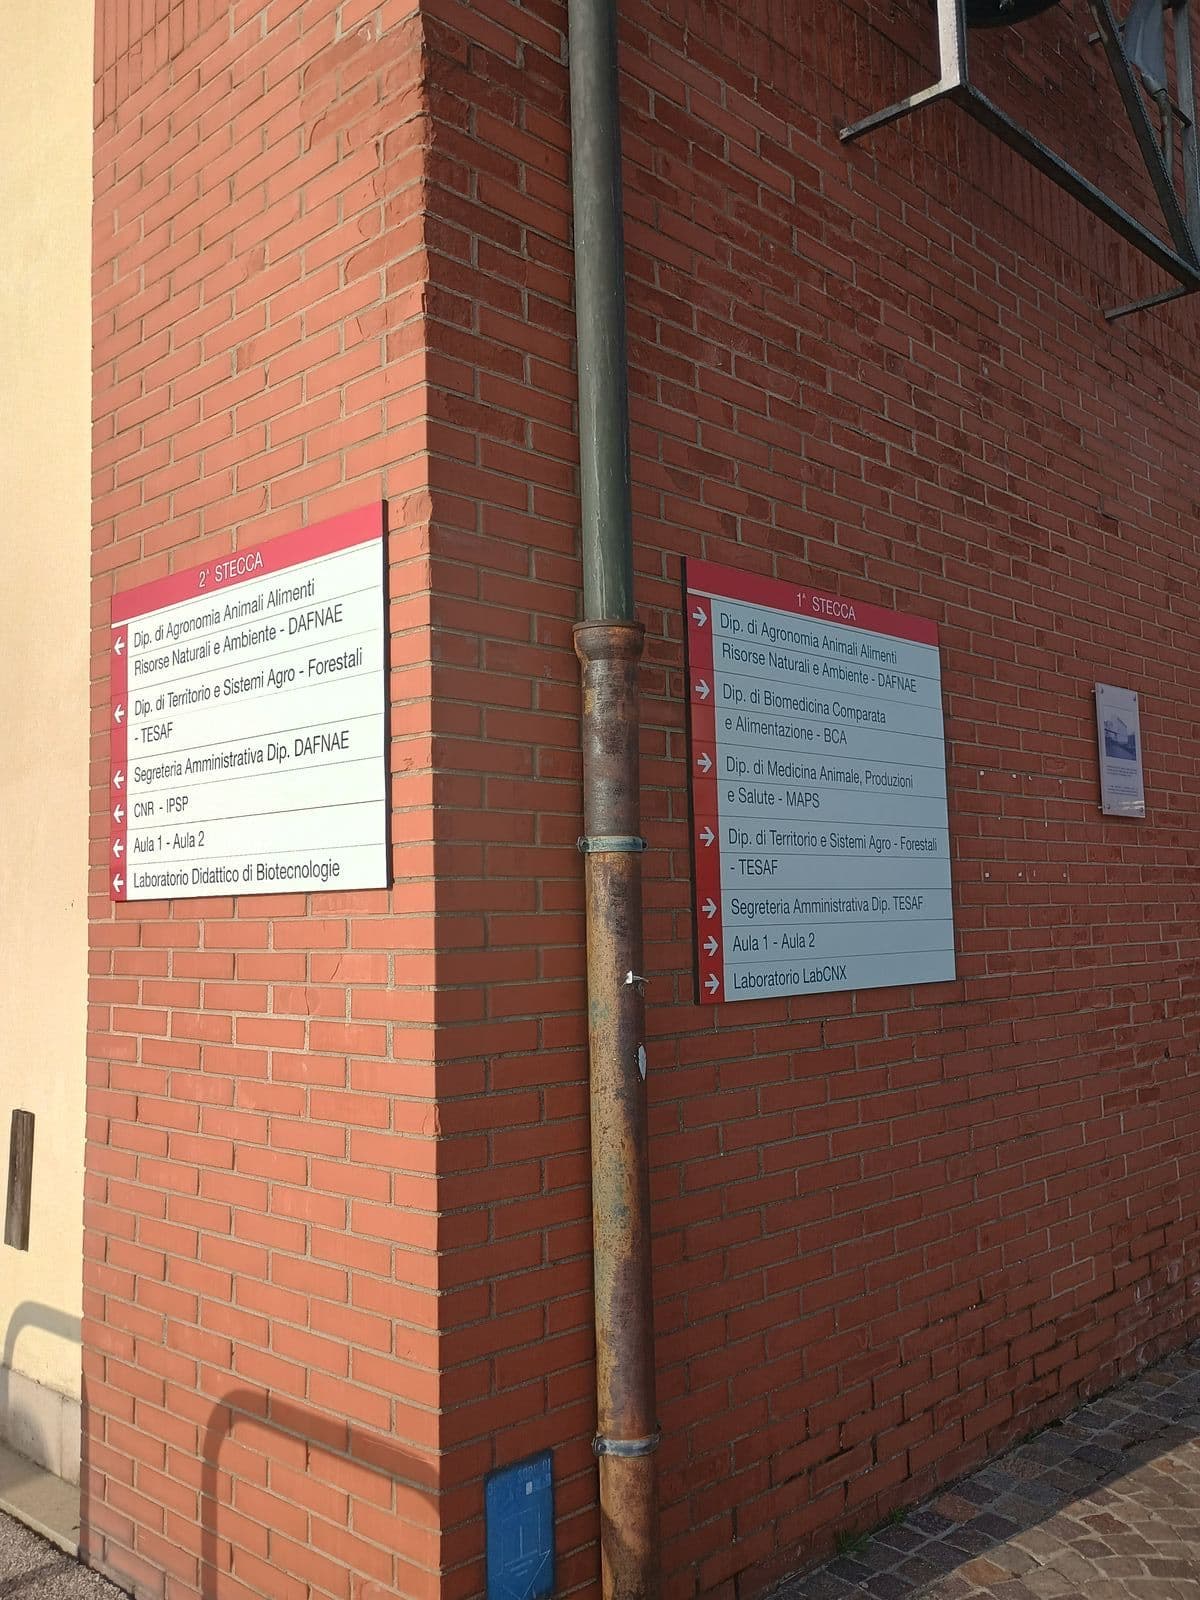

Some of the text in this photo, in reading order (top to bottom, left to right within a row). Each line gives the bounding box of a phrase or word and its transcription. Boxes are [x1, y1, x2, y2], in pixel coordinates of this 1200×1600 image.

[215, 551, 263, 582] STECCA
[134, 578, 315, 649] Dip. di Agronomia Animali Alimenti
[812, 596, 857, 621] STECCA
[134, 656, 170, 676] Risorse
[172, 641, 211, 666] Naturali
[213, 644, 221, 655] e
[223, 625, 277, 653] Ambiente
[288, 603, 343, 635] DAFNAE
[720, 612, 897, 665] Dip. di Agronomia Animali Alimenti
[134, 699, 153, 717] Dip.
[156, 694, 165, 710] di
[168, 685, 211, 708] Territorio
[214, 685, 221, 698] e
[223, 671, 264, 696] Sistemi
[267, 668, 296, 689] Agro
[308, 647, 363, 678] Forestali
[722, 642, 766, 666] Risorse
[768, 651, 810, 674] Naturali
[812, 664, 820, 676] e
[822, 662, 869, 685] Ambiente
[877, 672, 918, 693] DAFNAE
[723, 683, 886, 723] Dip. di Biomedicina Comparata
[141, 722, 174, 743] TESAF
[725, 718, 732, 730] e
[735, 715, 814, 741] Alimentazione
[824, 727, 847, 745] BCA
[134, 730, 350, 784] Segreteria Amministrativa Dip. DAFNAE
[726, 755, 914, 789] Dip. di Medicina Animale, Produzioni
[134, 801, 155, 818] CNR
[166, 796, 189, 813] IPSP
[727, 790, 735, 802] e
[738, 787, 775, 806] Salute
[786, 791, 820, 809] MAPS
[133, 837, 155, 853] Aula
[157, 835, 162, 850] 1
[172, 832, 196, 849] Aula
[198, 830, 205, 847] 2
[728, 828, 752, 849] Dip.
[755, 829, 767, 846] di
[769, 829, 818, 848] Territorio
[820, 836, 827, 848] e
[829, 832, 867, 849] Sistemi
[868, 834, 892, 854] Agro
[900, 835, 938, 852] Forestali
[133, 858, 341, 888] Laboratorio Didattico di Biotecnologie
[738, 859, 779, 876] TESAF
[731, 895, 923, 919] Segreteria Amministrativa Dip. TESAF
[732, 935, 760, 953] Aula
[763, 934, 768, 951] 1
[781, 932, 806, 950] Aula
[808, 931, 815, 948] 2
[733, 964, 848, 990] Laboratorio LabCNX
